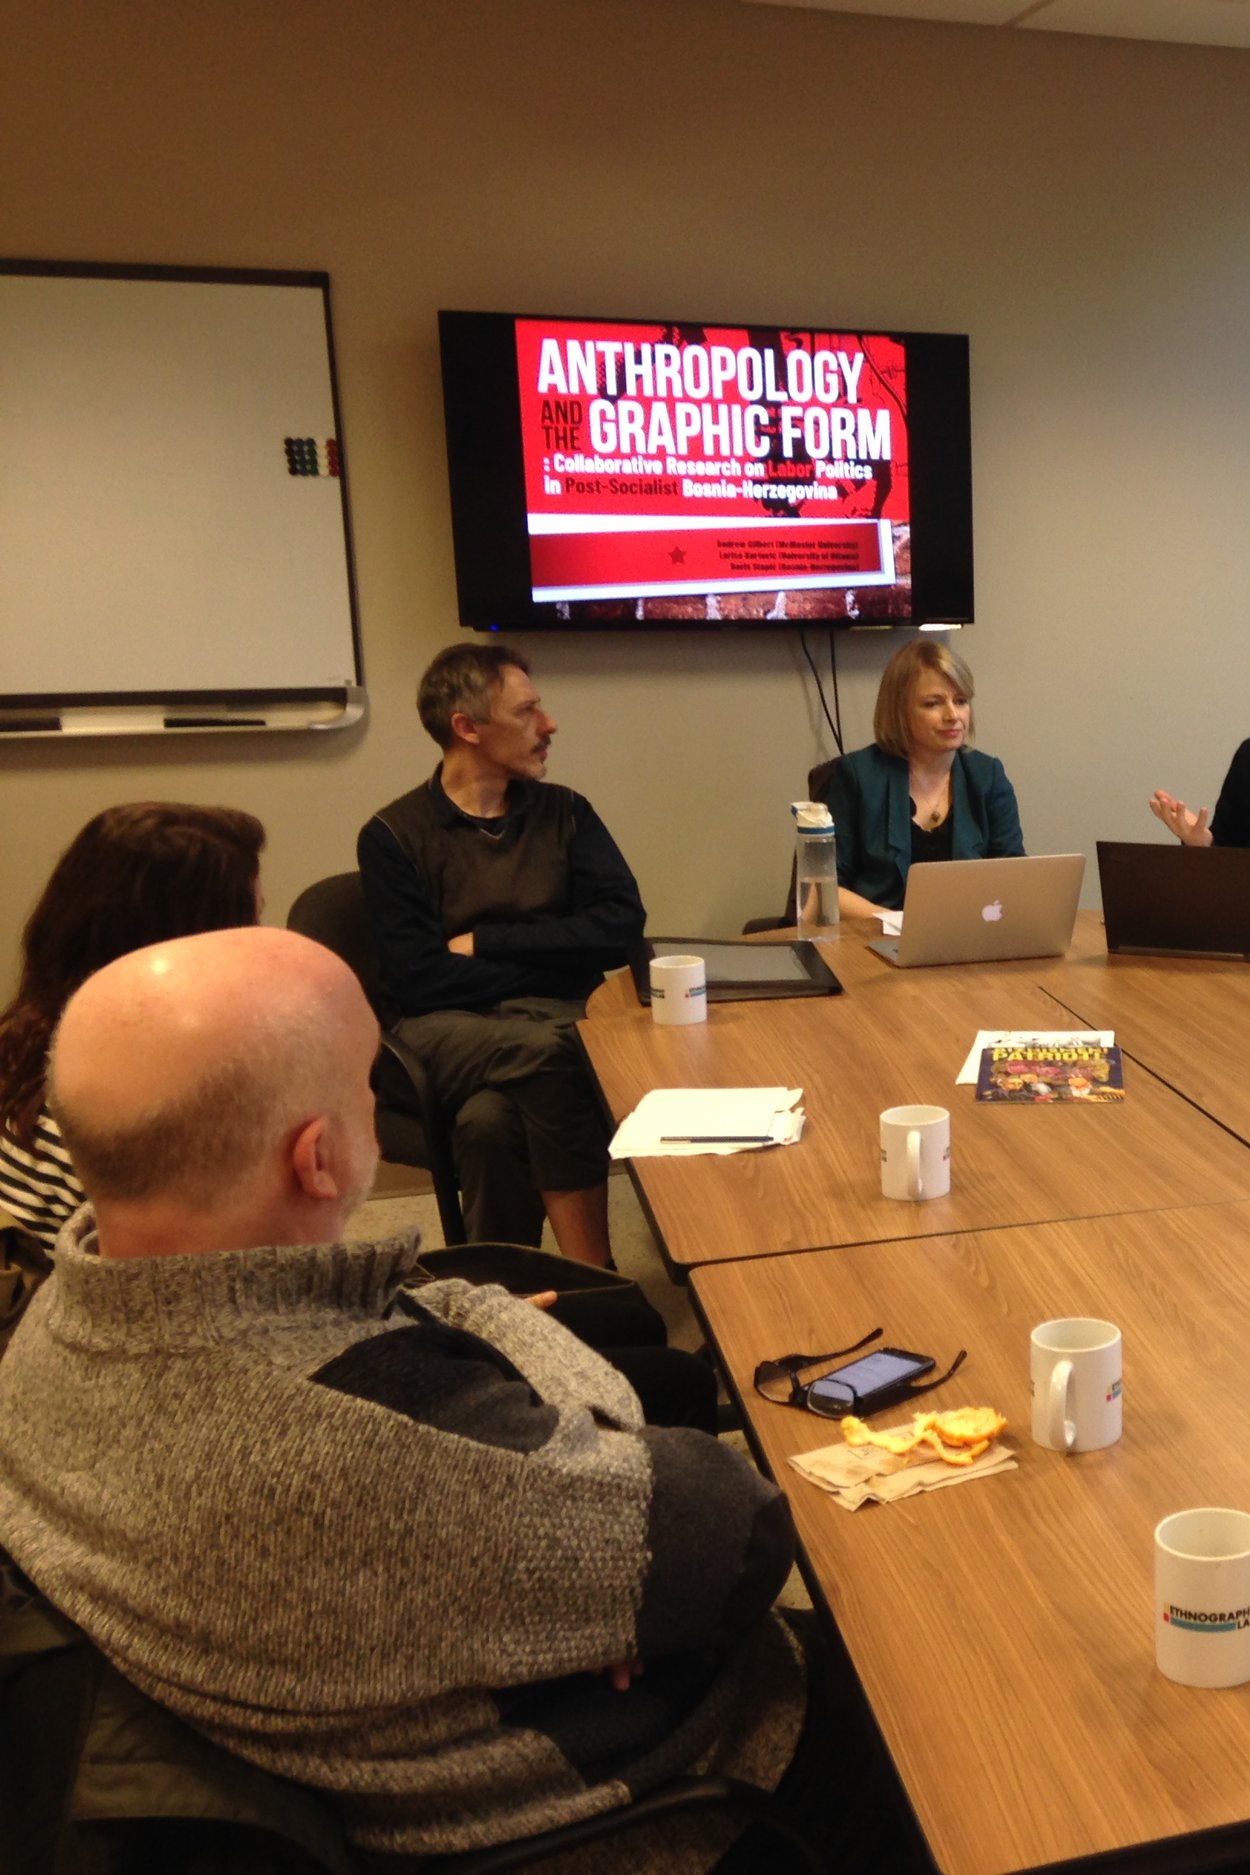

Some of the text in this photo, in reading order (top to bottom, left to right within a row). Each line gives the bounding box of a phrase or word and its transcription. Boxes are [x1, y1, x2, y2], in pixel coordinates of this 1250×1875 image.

[537, 338, 864, 404] ANTHROPOLOGY
[541, 400, 583, 425] AND
[541, 426, 581, 450] THE
[589, 398, 892, 461] GRAPHIC FORM
[553, 453, 663, 475] Collaborative
[666, 456, 742, 477] Research
[744, 461, 765, 477] on
[768, 459, 813, 478] Labor
[815, 460, 873, 480] Politics
[543, 475, 838, 505] in Post-Socialist Bosnia-Herzegovina
